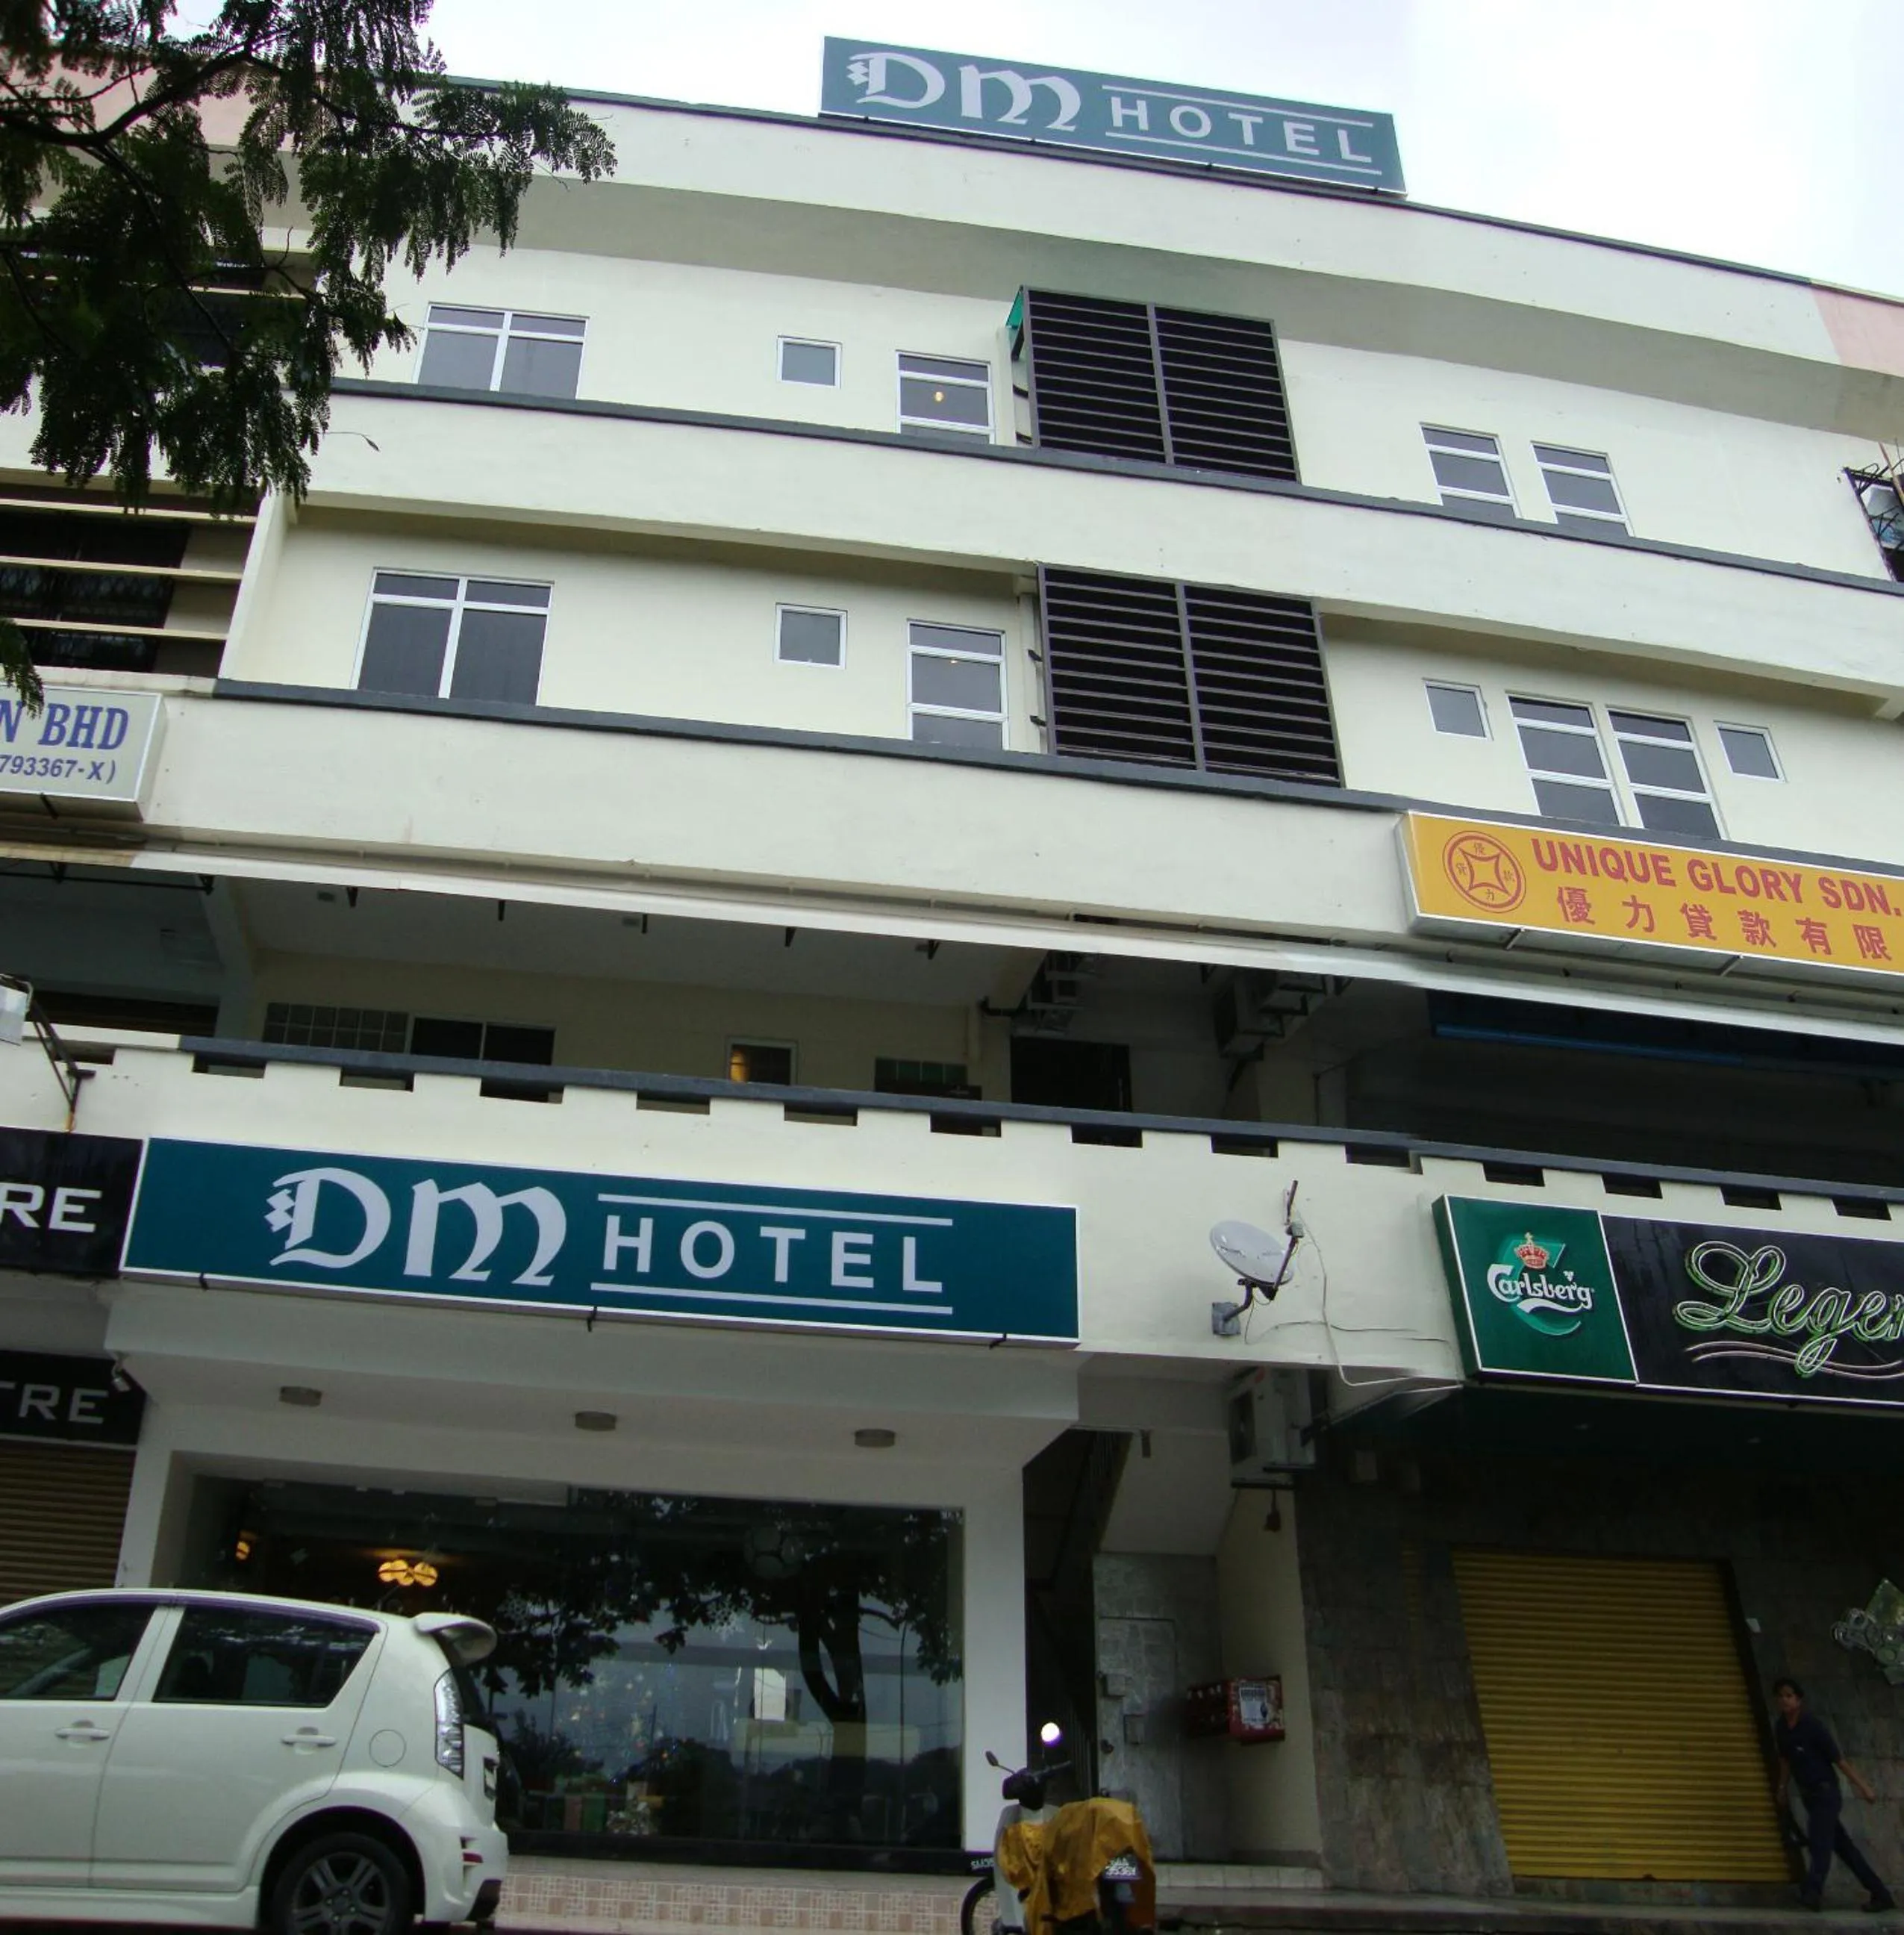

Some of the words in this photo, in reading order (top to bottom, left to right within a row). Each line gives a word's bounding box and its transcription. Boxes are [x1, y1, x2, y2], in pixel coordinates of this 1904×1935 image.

[846, 52, 1080, 131] DM
[1110, 96, 1373, 163] HOTEL
[38, 702, 129, 750] BHD
[1531, 838, 1676, 888] UNIQUE
[1687, 859, 1803, 903] GLORY
[1818, 876, 1902, 917] SDN.
[1557, 885, 1892, 962] 優力貸款有限
[266, 1167, 567, 1286] DM
[602, 1216, 943, 1293] HOTEL
[1486, 1263, 1593, 1311] Carlsberg
